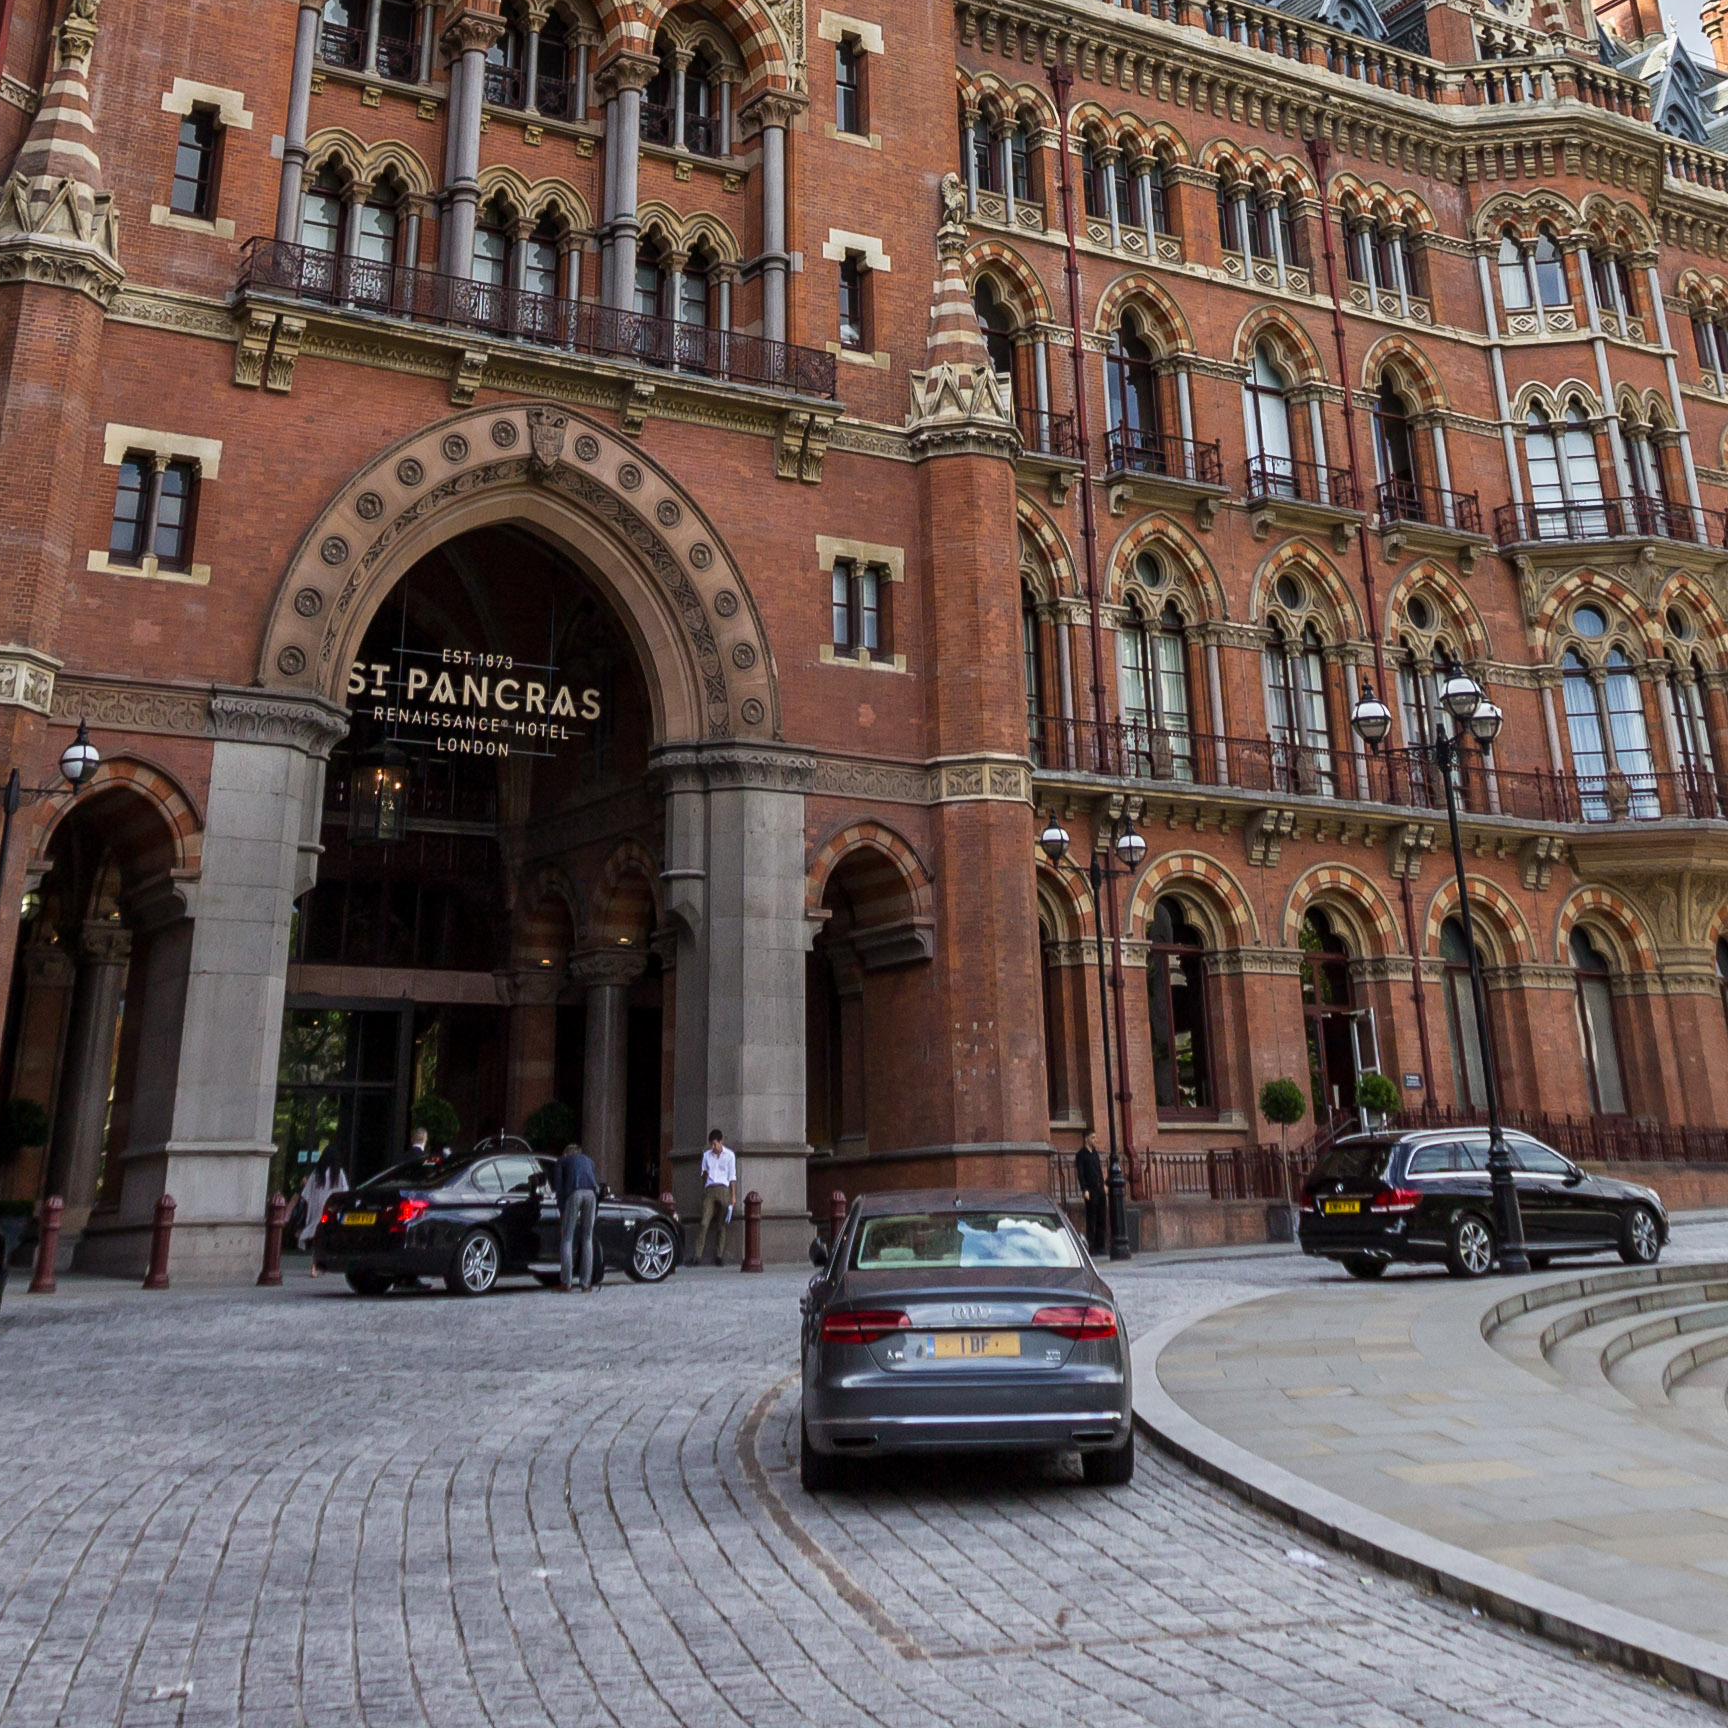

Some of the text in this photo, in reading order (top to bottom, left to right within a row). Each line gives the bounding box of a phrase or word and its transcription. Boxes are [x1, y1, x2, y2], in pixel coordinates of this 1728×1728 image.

[406, 668, 601, 720] PANCRAS
[515, 722, 570, 740] HOTEL
[437, 737, 509, 757] LONDON
